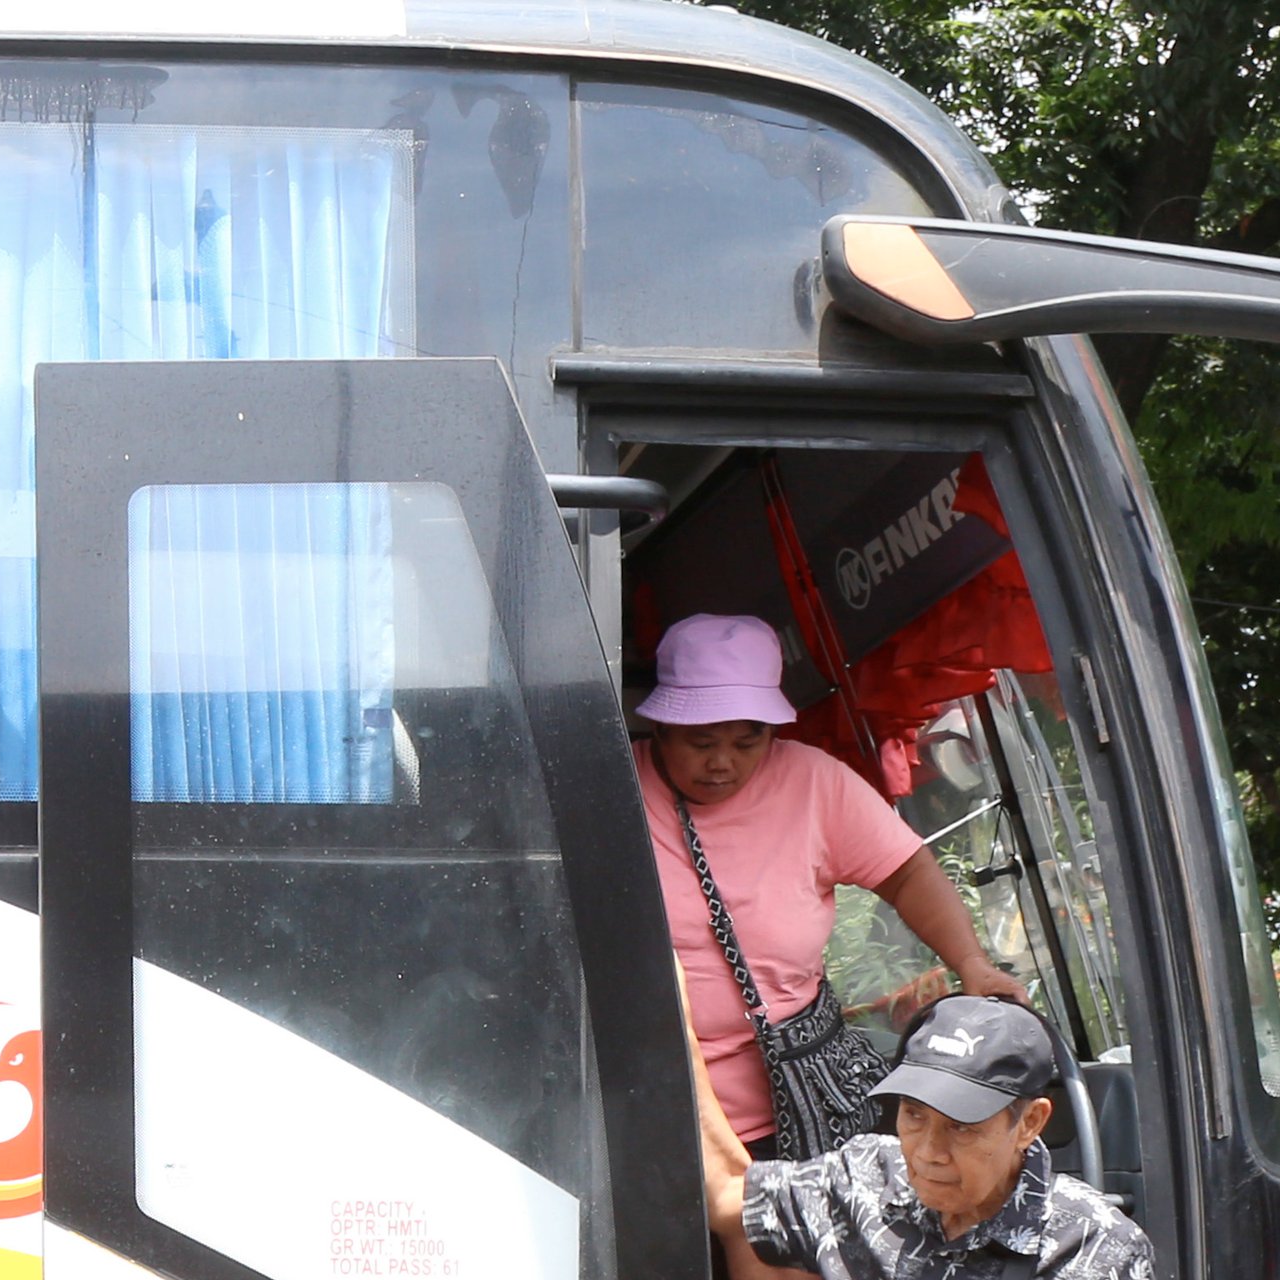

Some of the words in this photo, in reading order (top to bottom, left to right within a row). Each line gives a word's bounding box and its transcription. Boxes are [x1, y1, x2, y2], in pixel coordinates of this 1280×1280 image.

[862, 467, 966, 586] ANKA
[329, 1199, 415, 1218] CAPACITY
[386, 1219, 429, 1237] HMTI
[329, 1237, 355, 1256] GR
[400, 1239, 446, 1257] 15000
[329, 1257, 384, 1276] TOTAL
[442, 1258, 461, 1277] 61
